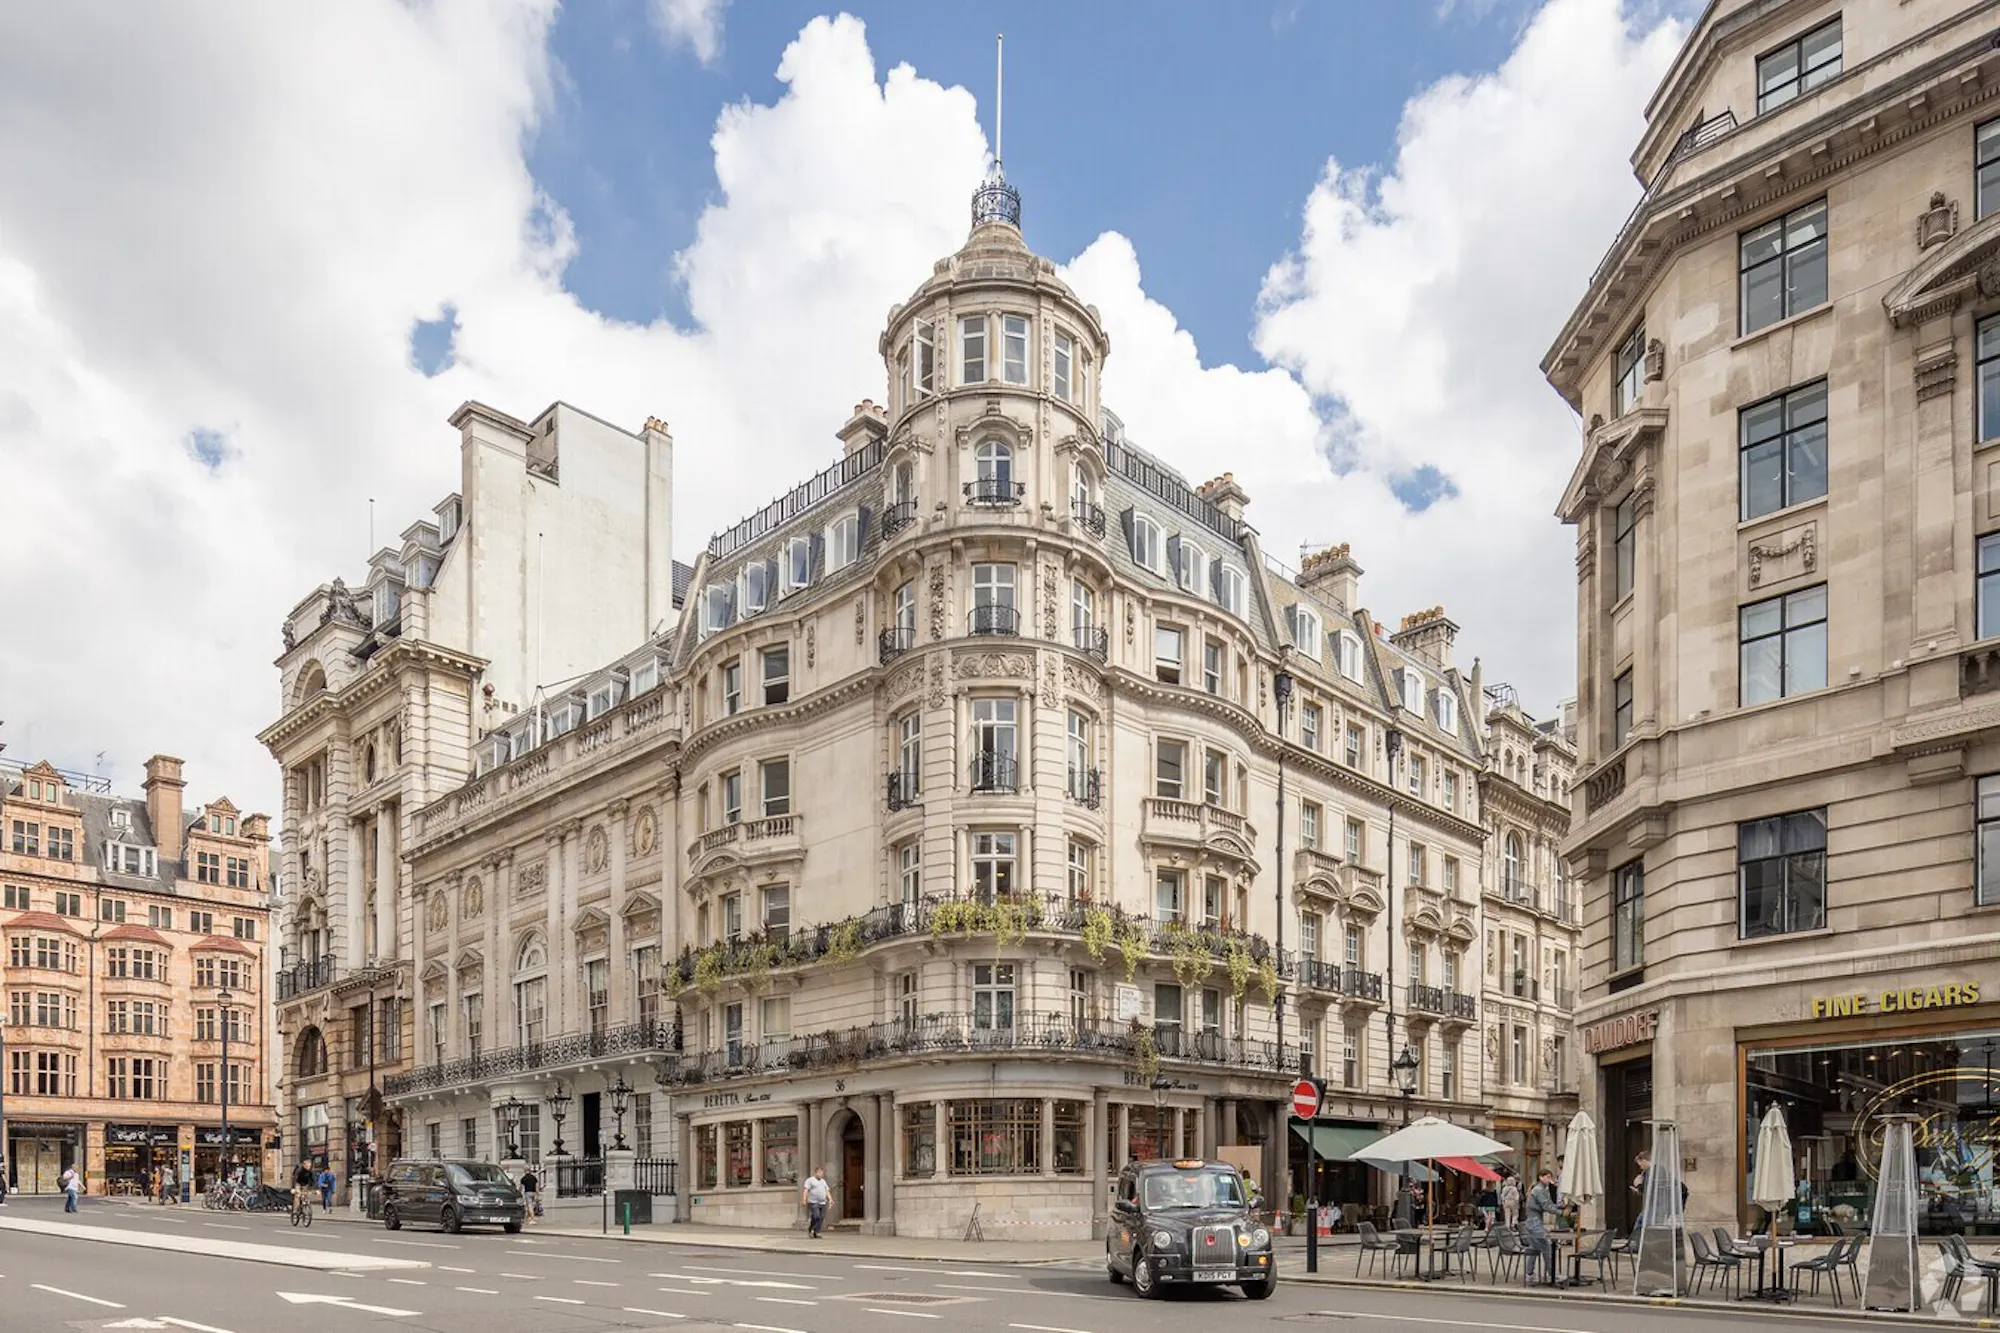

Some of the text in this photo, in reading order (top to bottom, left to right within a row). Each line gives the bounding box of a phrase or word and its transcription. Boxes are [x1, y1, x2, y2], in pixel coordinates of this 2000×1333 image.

[1812, 982, 1980, 1018] FINE CIGARS
[1585, 1008, 1659, 1054] DAVIDOFF
[835, 1079, 846, 1092] 36
[703, 1092, 740, 1108] BERETTA
